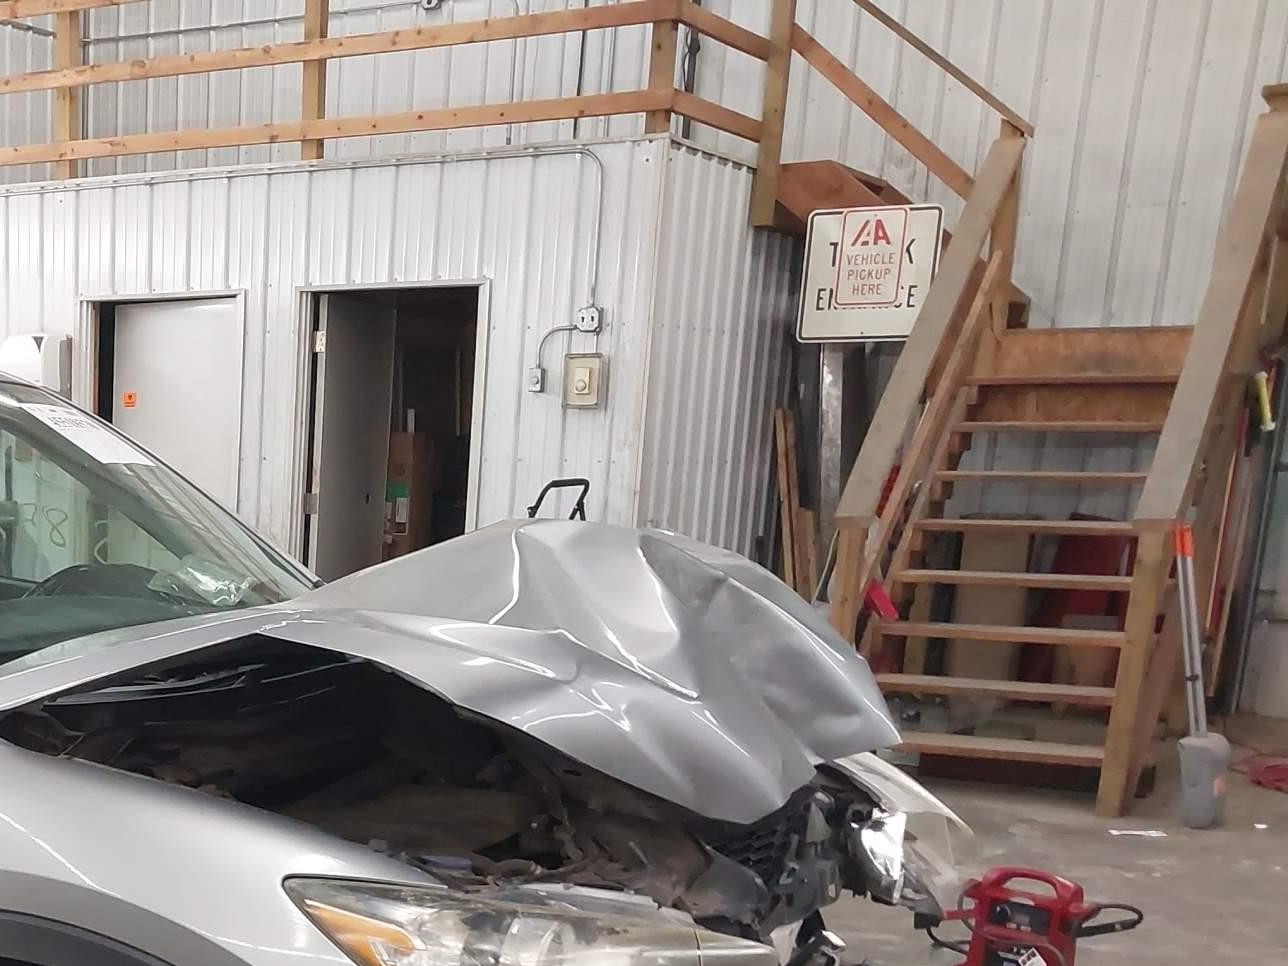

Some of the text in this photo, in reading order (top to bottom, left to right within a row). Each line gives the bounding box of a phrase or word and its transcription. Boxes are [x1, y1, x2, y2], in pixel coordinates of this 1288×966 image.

[846, 252, 896, 266] VEHICLE
[846, 267, 892, 281] PICKUP
[851, 283, 884, 296] HERE
